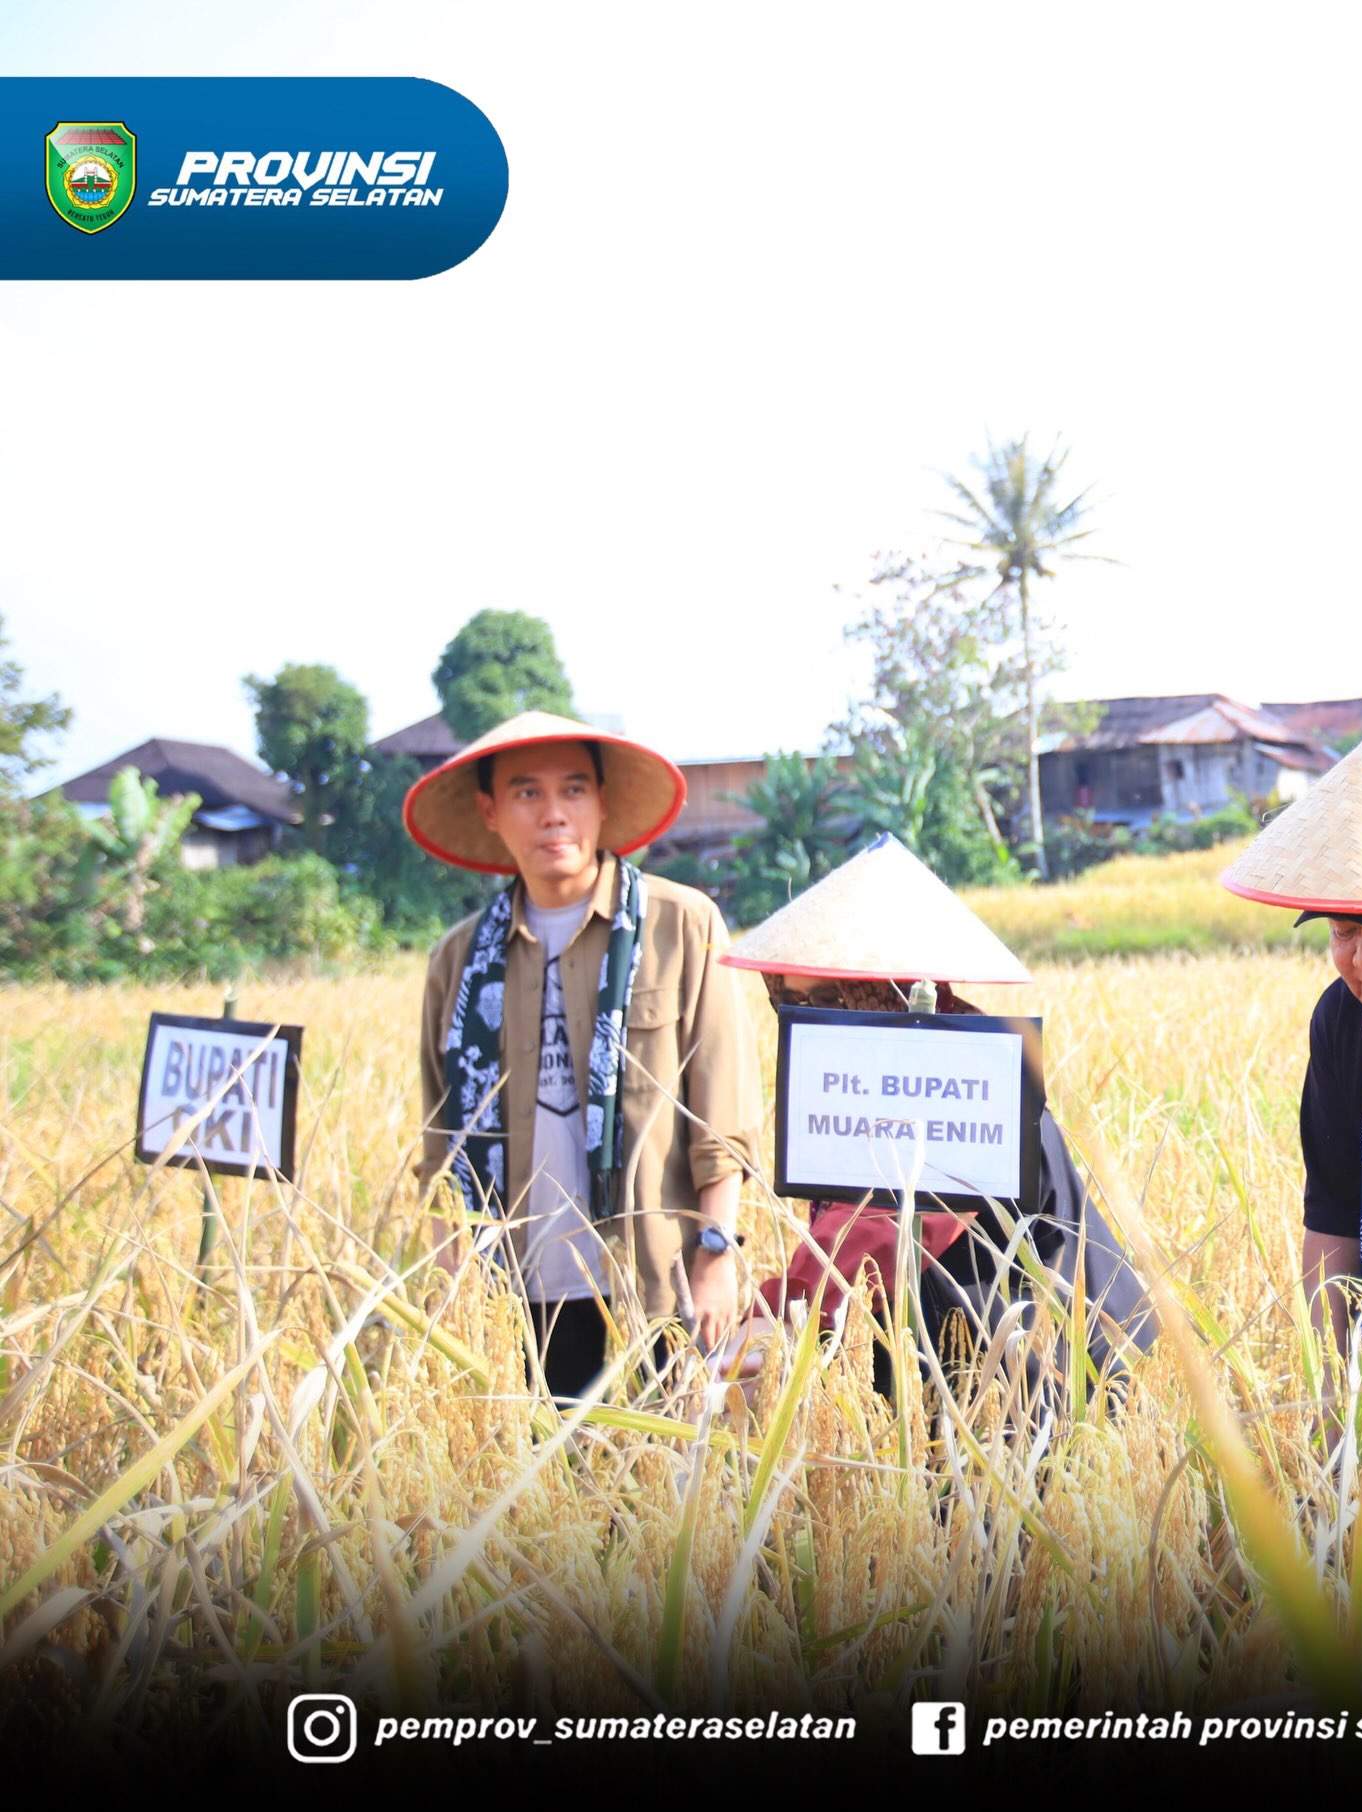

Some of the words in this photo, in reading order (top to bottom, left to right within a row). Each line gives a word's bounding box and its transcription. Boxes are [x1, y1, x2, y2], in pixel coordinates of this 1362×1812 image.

[162, 1041, 278, 1109] BUPATI
[822, 1072, 870, 1095] Plt.
[881, 1075, 989, 1101] BUPATI
[808, 1114, 915, 1141] MUARA
[926, 1120, 1004, 1145] ENIM
